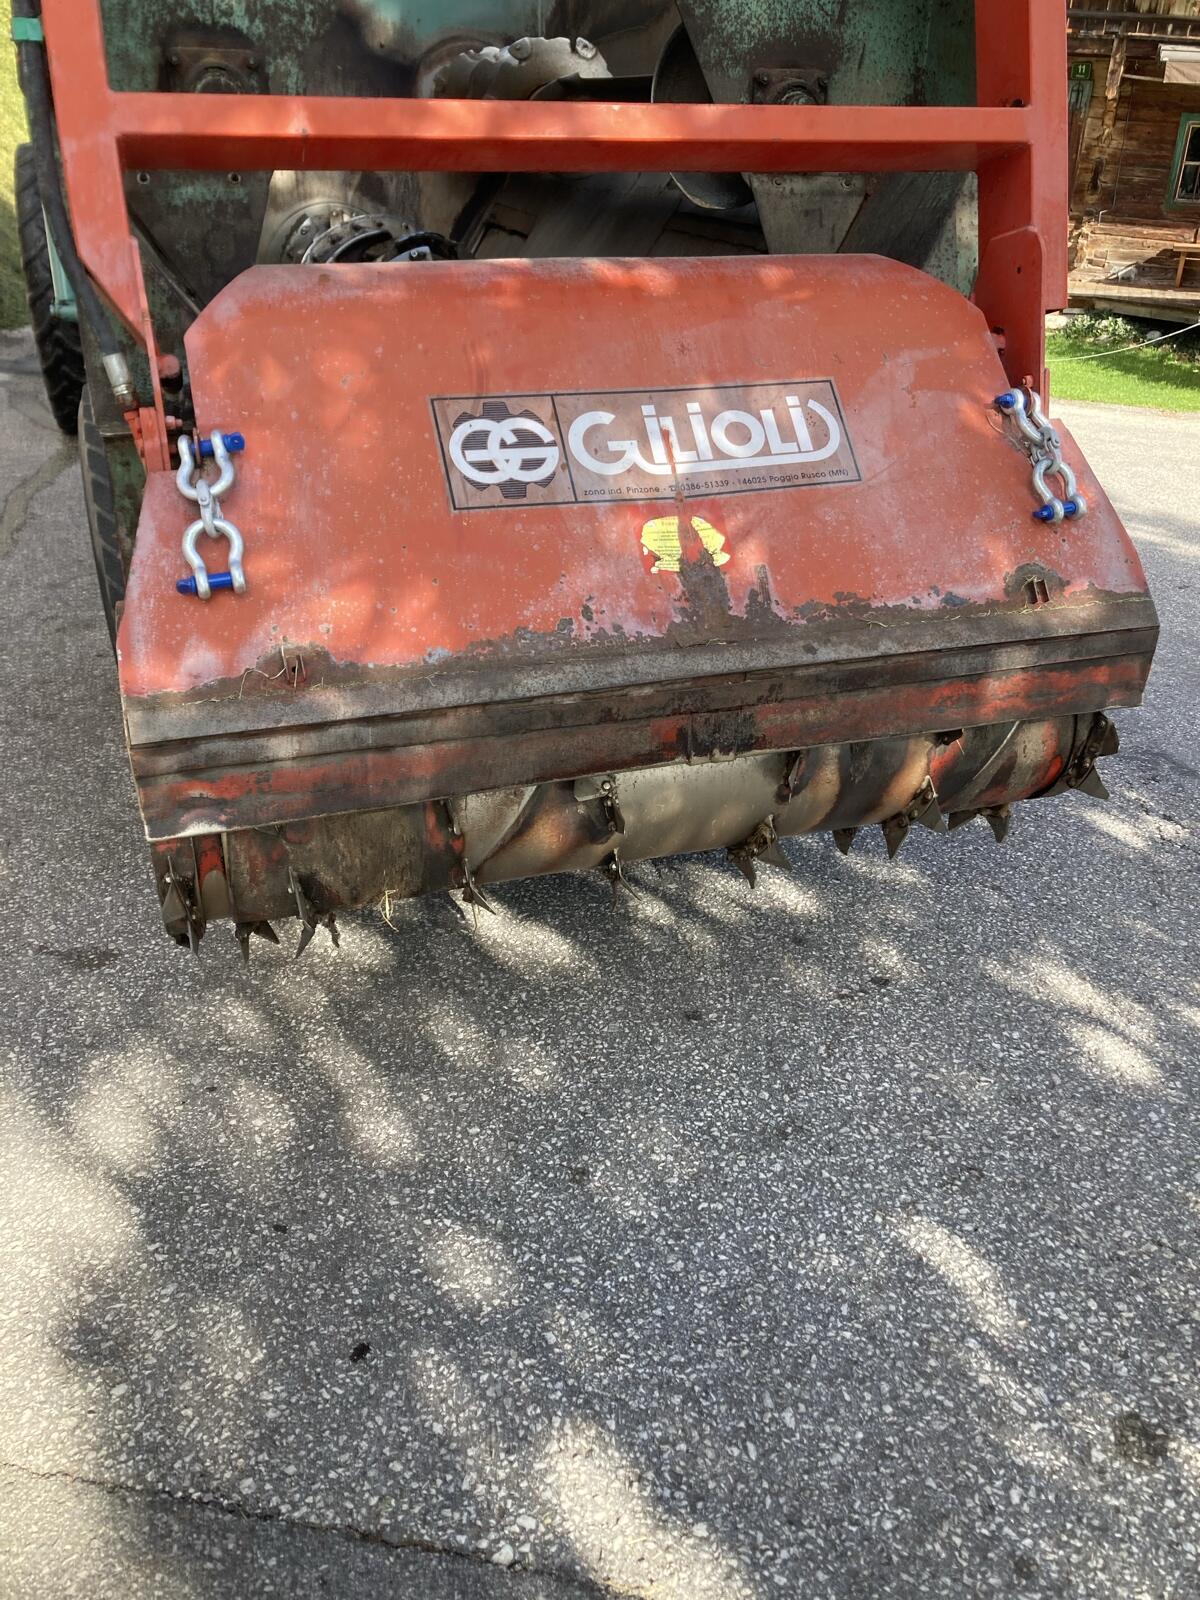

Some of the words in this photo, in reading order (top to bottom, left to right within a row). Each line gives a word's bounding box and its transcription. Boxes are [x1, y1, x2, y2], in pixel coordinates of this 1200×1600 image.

[1078, 64, 1086, 73] 11
[681, 479, 729, 491] 0386-51339
[769, 473, 799, 482] Poggio
[800, 471, 827, 479] Rusco
[828, 468, 849, 478] (MN)
